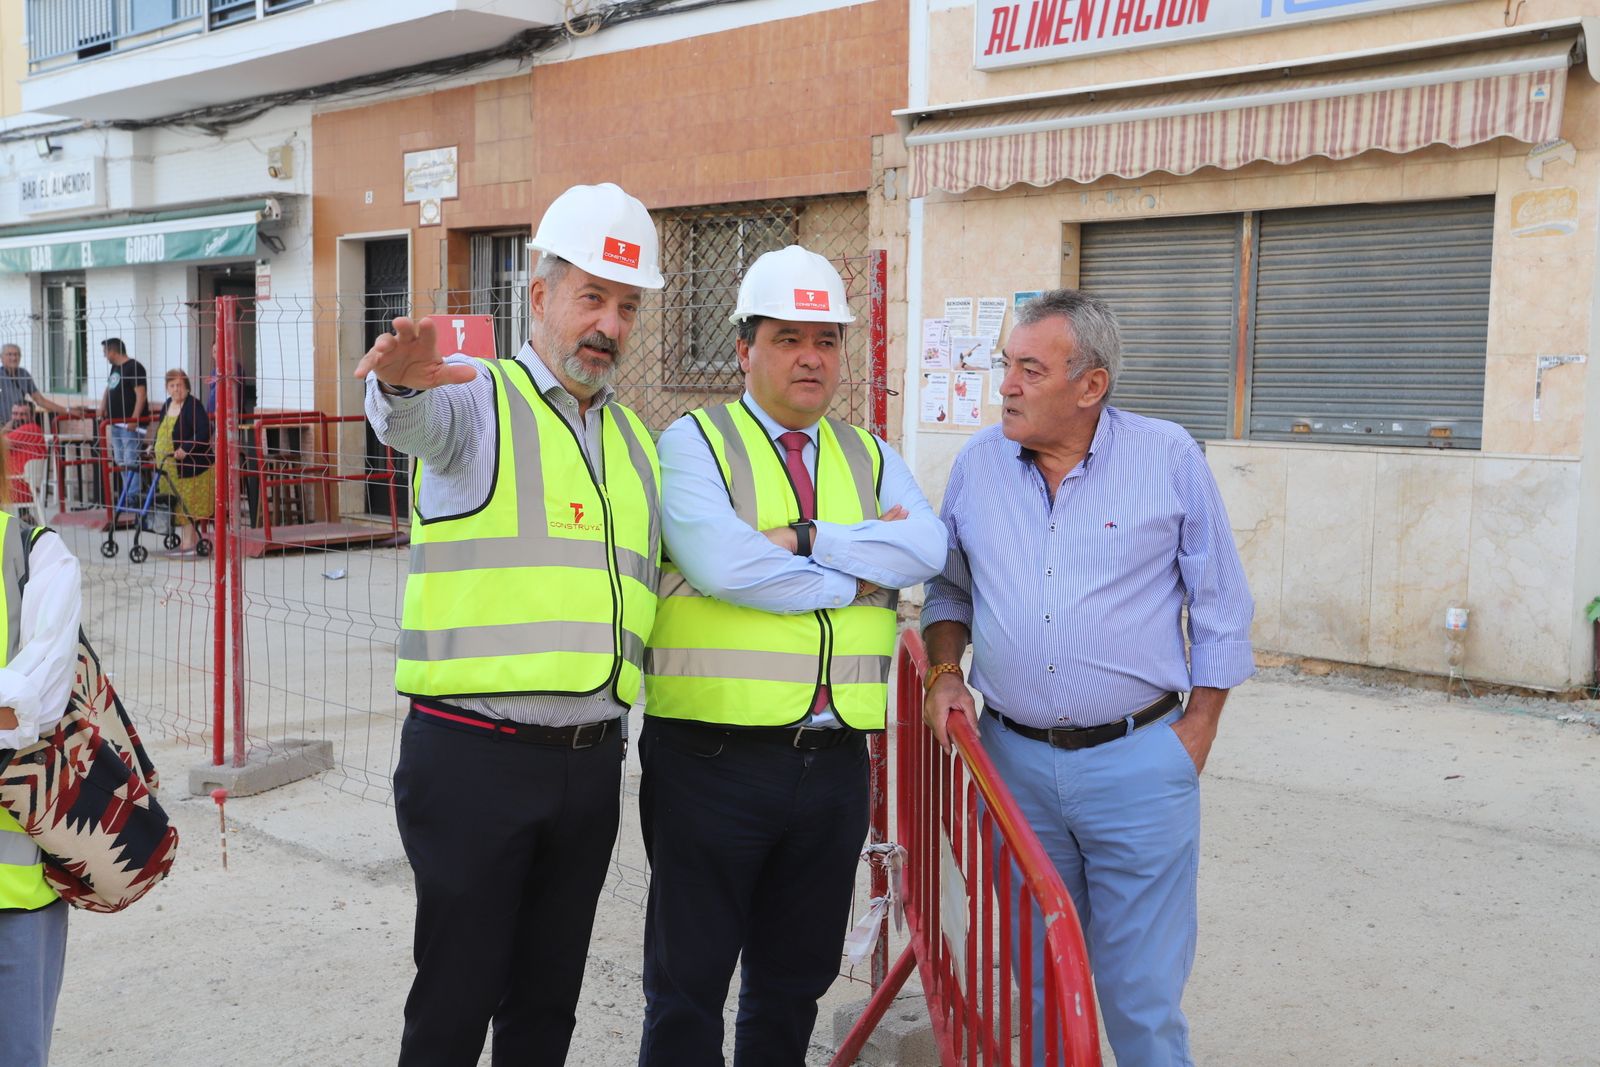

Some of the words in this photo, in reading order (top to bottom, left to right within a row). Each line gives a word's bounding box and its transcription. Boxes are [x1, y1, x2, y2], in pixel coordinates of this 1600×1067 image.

[22, 181, 36, 200] BAR
[40, 179, 49, 198] EL
[51, 171, 91, 197] ALMENDRO
[31, 246, 52, 271] BAR
[80, 242, 94, 268] EL
[125, 234, 165, 264] GORDO
[604, 251, 636, 265] CONSTRUYA
[550, 521, 601, 531] CONSTRUYA
